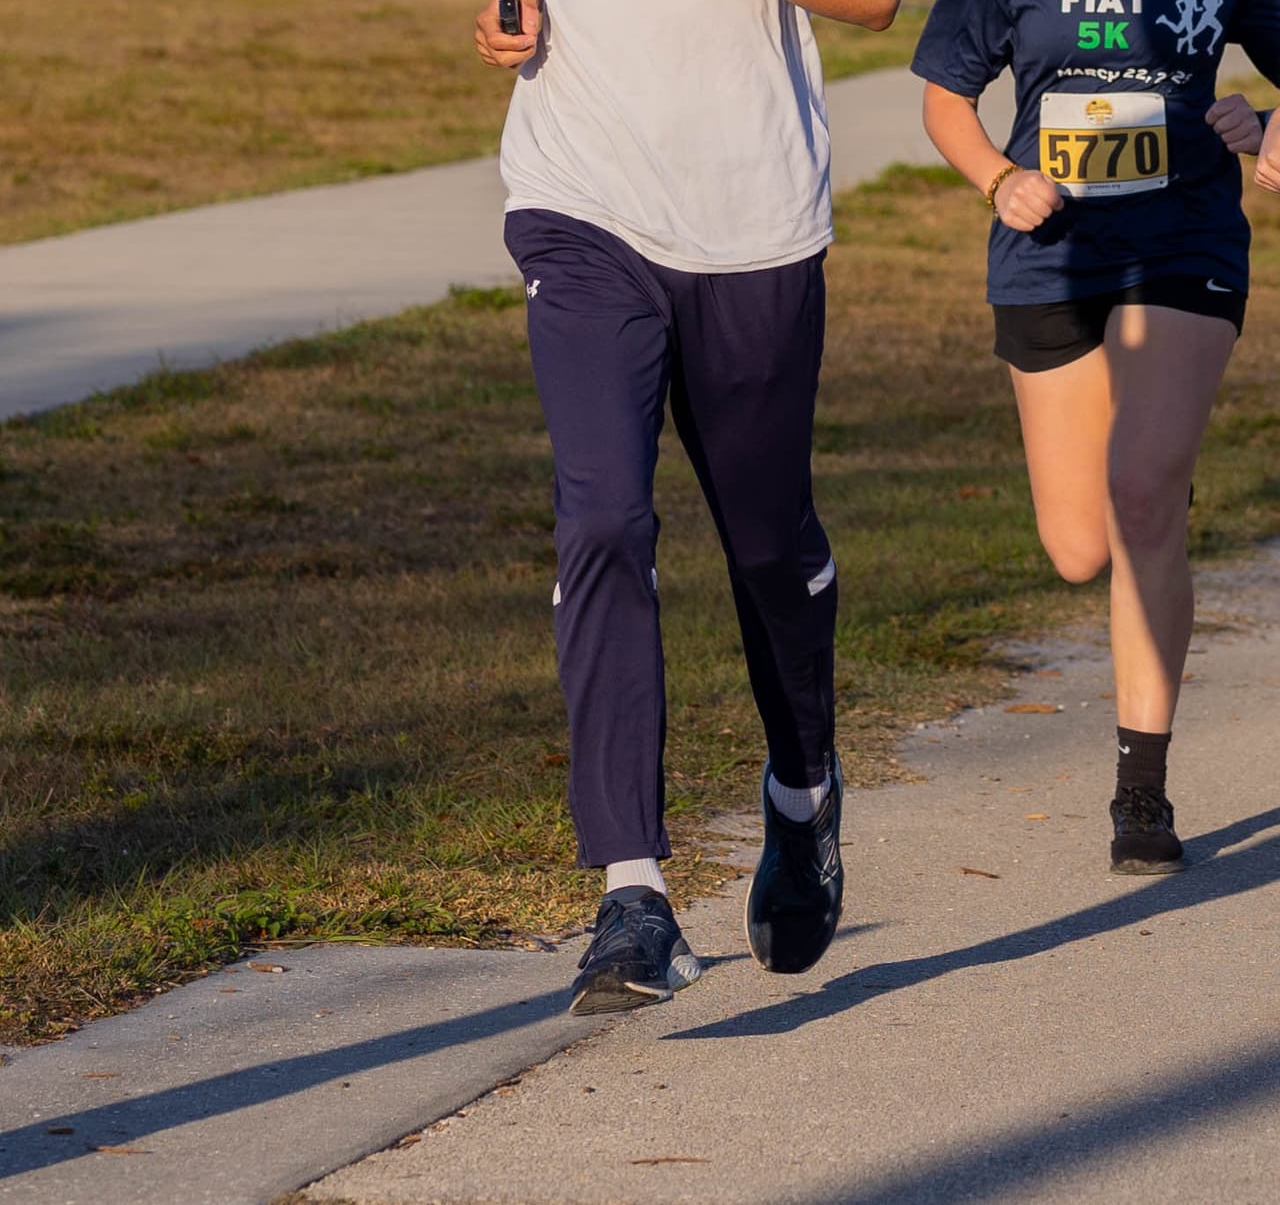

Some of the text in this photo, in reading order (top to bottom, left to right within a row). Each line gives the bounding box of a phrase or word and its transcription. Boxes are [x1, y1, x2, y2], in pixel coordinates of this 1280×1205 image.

[1077, 21, 1130, 50] 5K
[1122, 67, 1152, 84] 22,
[1047, 131, 1161, 180] 5770
